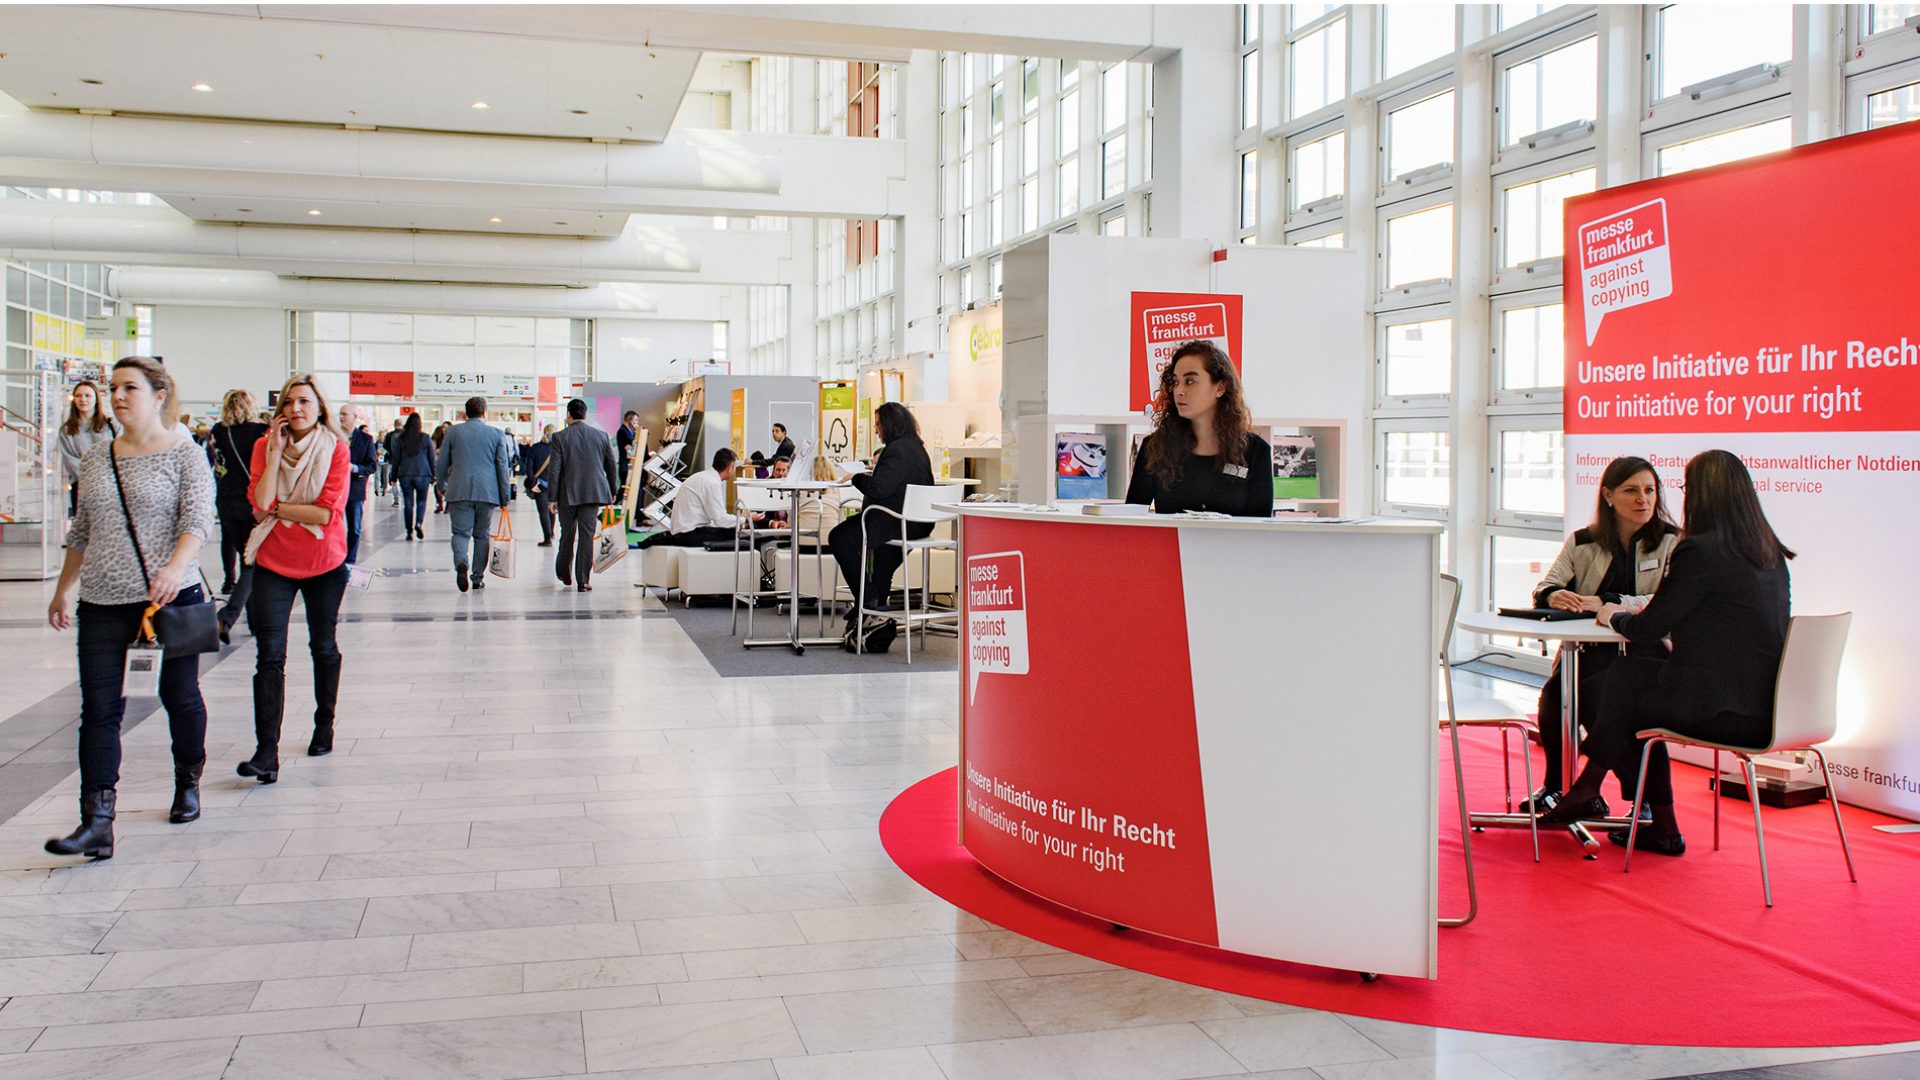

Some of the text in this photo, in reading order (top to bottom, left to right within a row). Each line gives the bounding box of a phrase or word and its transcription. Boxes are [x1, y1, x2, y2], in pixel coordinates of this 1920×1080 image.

[1586, 217, 1634, 245] messe
[1587, 228, 1654, 264] frankfurt
[1590, 258, 1644, 288] against
[1591, 280, 1649, 307] copying
[1151, 311, 1197, 325] messe
[1152, 322, 1215, 340] frankfurt
[1578, 337, 1920, 384] Unsere Initiative für Ihr Rech
[1578, 385, 1862, 420] Our initiative for your right
[1740, 454, 1851, 470] htsanwaltlicher
[1774, 478, 1822, 493] service
[970, 564, 998, 582] messe
[971, 584, 1014, 606] frankfurt
[972, 615, 1006, 640] against
[973, 640, 1011, 667] copying
[1863, 766, 1920, 794] frankfu
[966, 760, 1176, 849] Unsere Initiative für Ihr Recht
[966, 789, 1125, 873] Our initiative for your right
